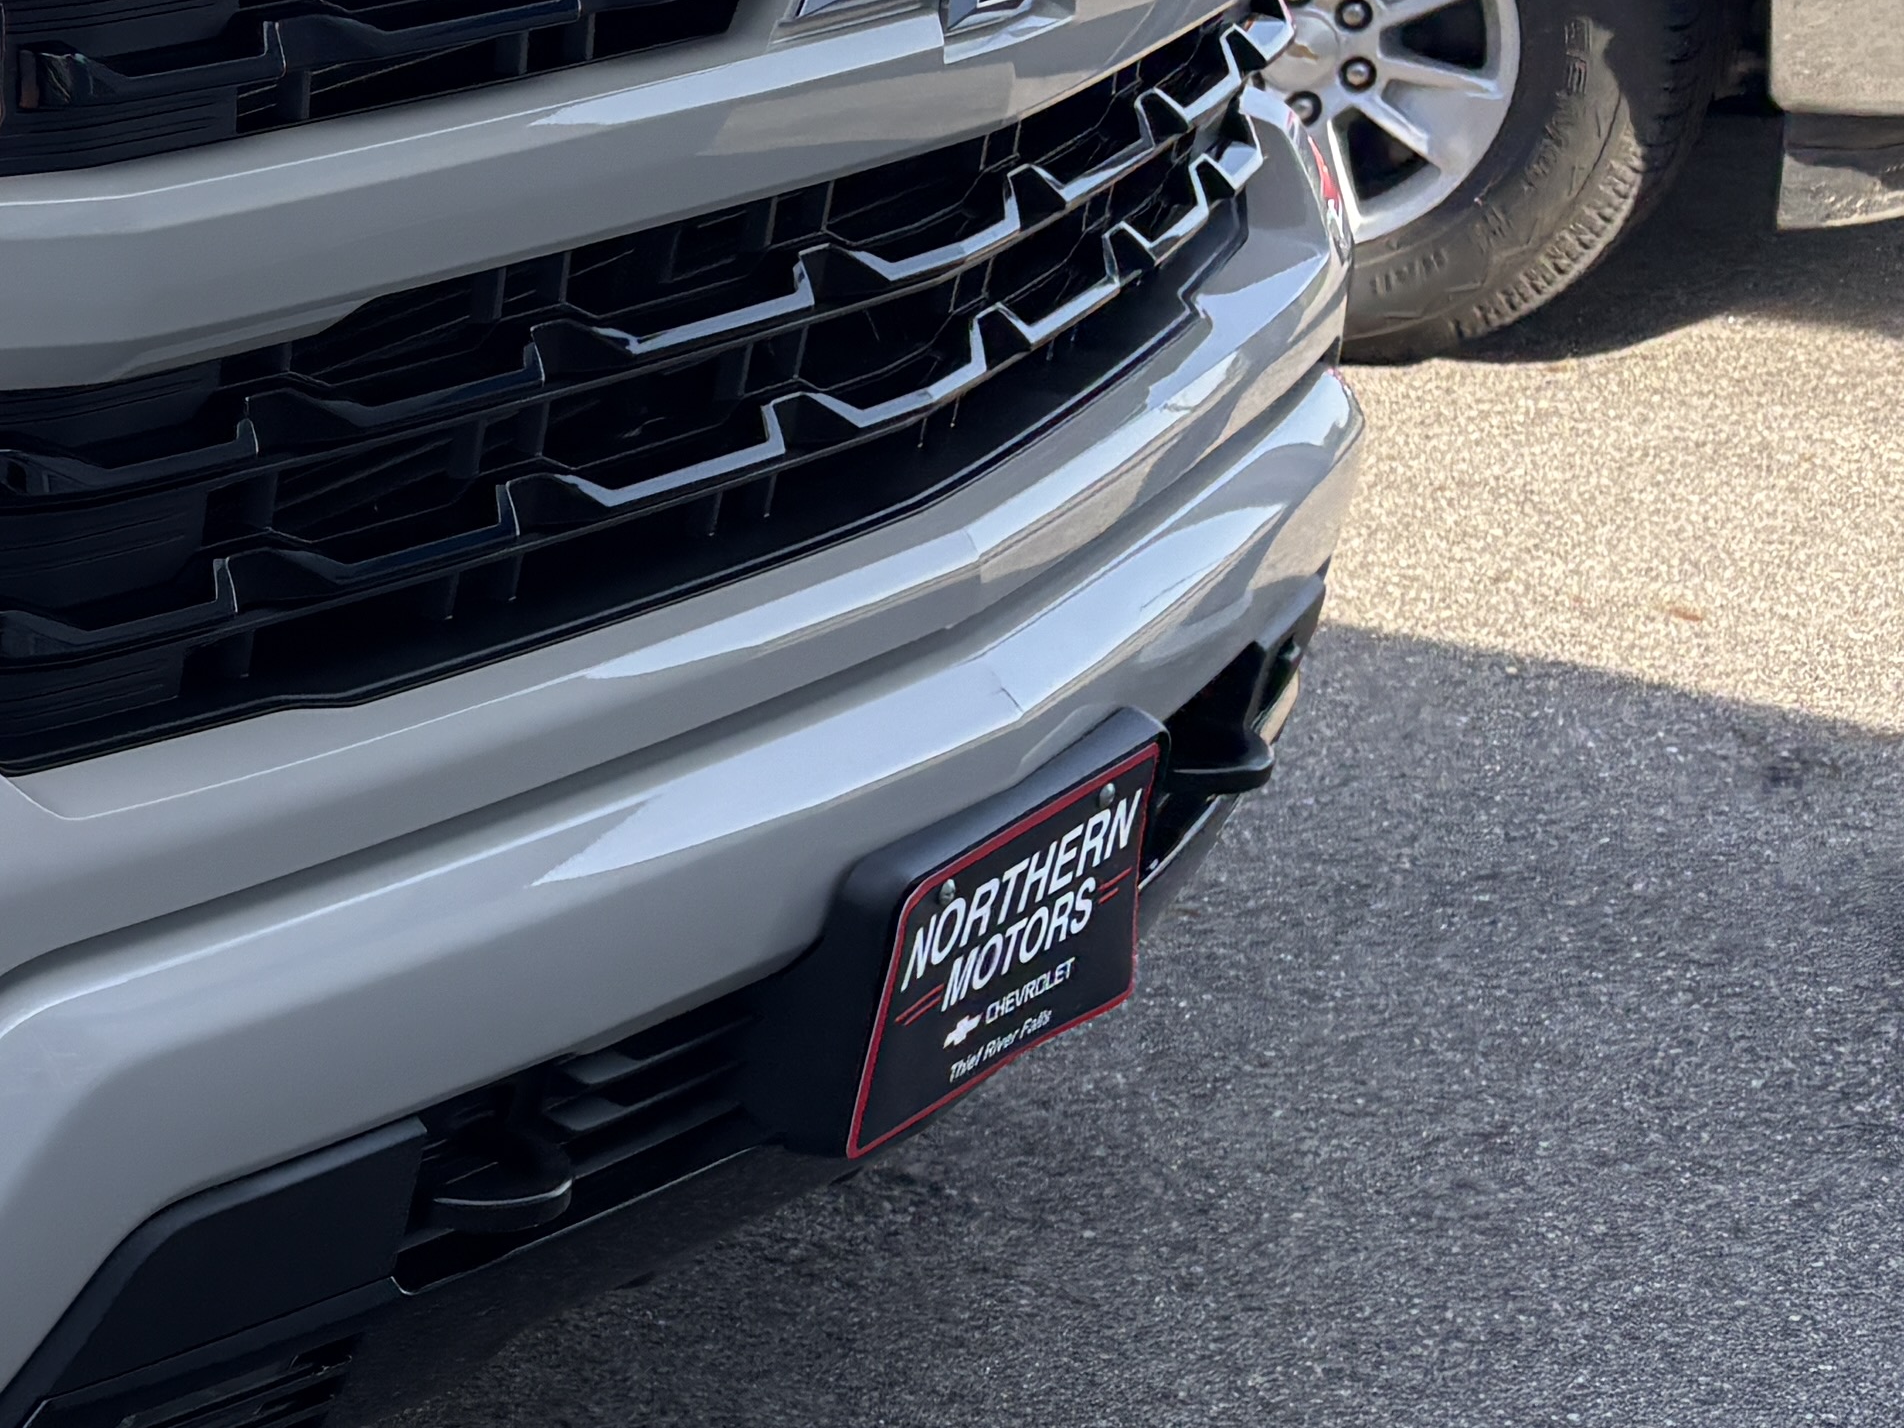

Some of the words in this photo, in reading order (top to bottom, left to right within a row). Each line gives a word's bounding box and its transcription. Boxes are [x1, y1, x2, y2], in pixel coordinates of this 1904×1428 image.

[900, 788, 1143, 992] NORTHERN
[940, 876, 1097, 1013] MOTORS
[985, 957, 1076, 1024] CHEVROLET
[949, 1051, 982, 1083] Thief
[983, 1026, 1020, 1061] River
[1019, 1009, 1053, 1040] Falls
